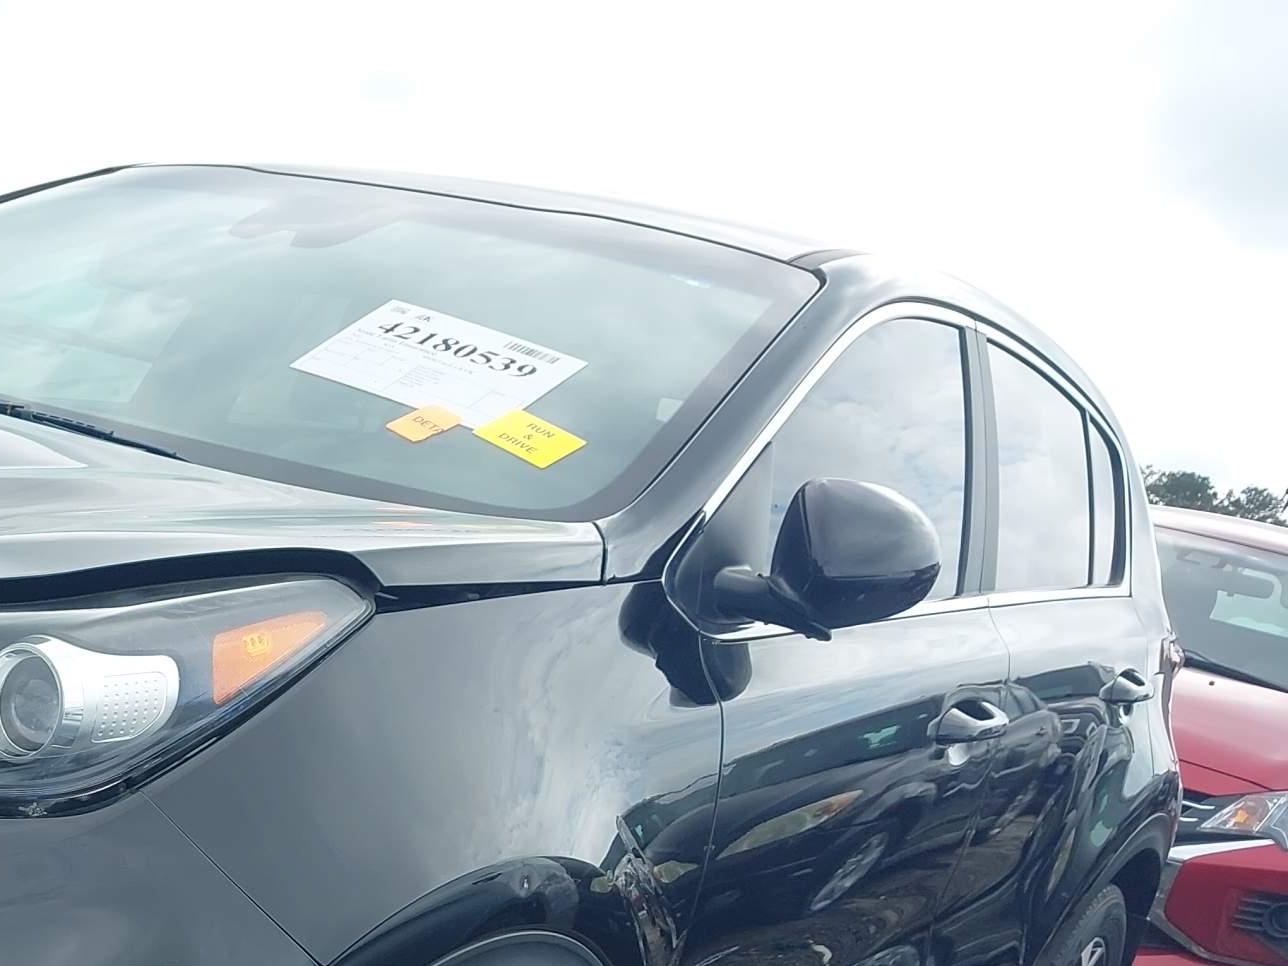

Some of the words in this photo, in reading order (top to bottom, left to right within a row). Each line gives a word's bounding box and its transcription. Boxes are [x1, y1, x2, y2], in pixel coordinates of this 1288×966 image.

[377, 322, 537, 377] 42180539
[522, 433, 534, 441] &
[525, 422, 556, 439] RUN
[497, 432, 539, 454] DRIVE
